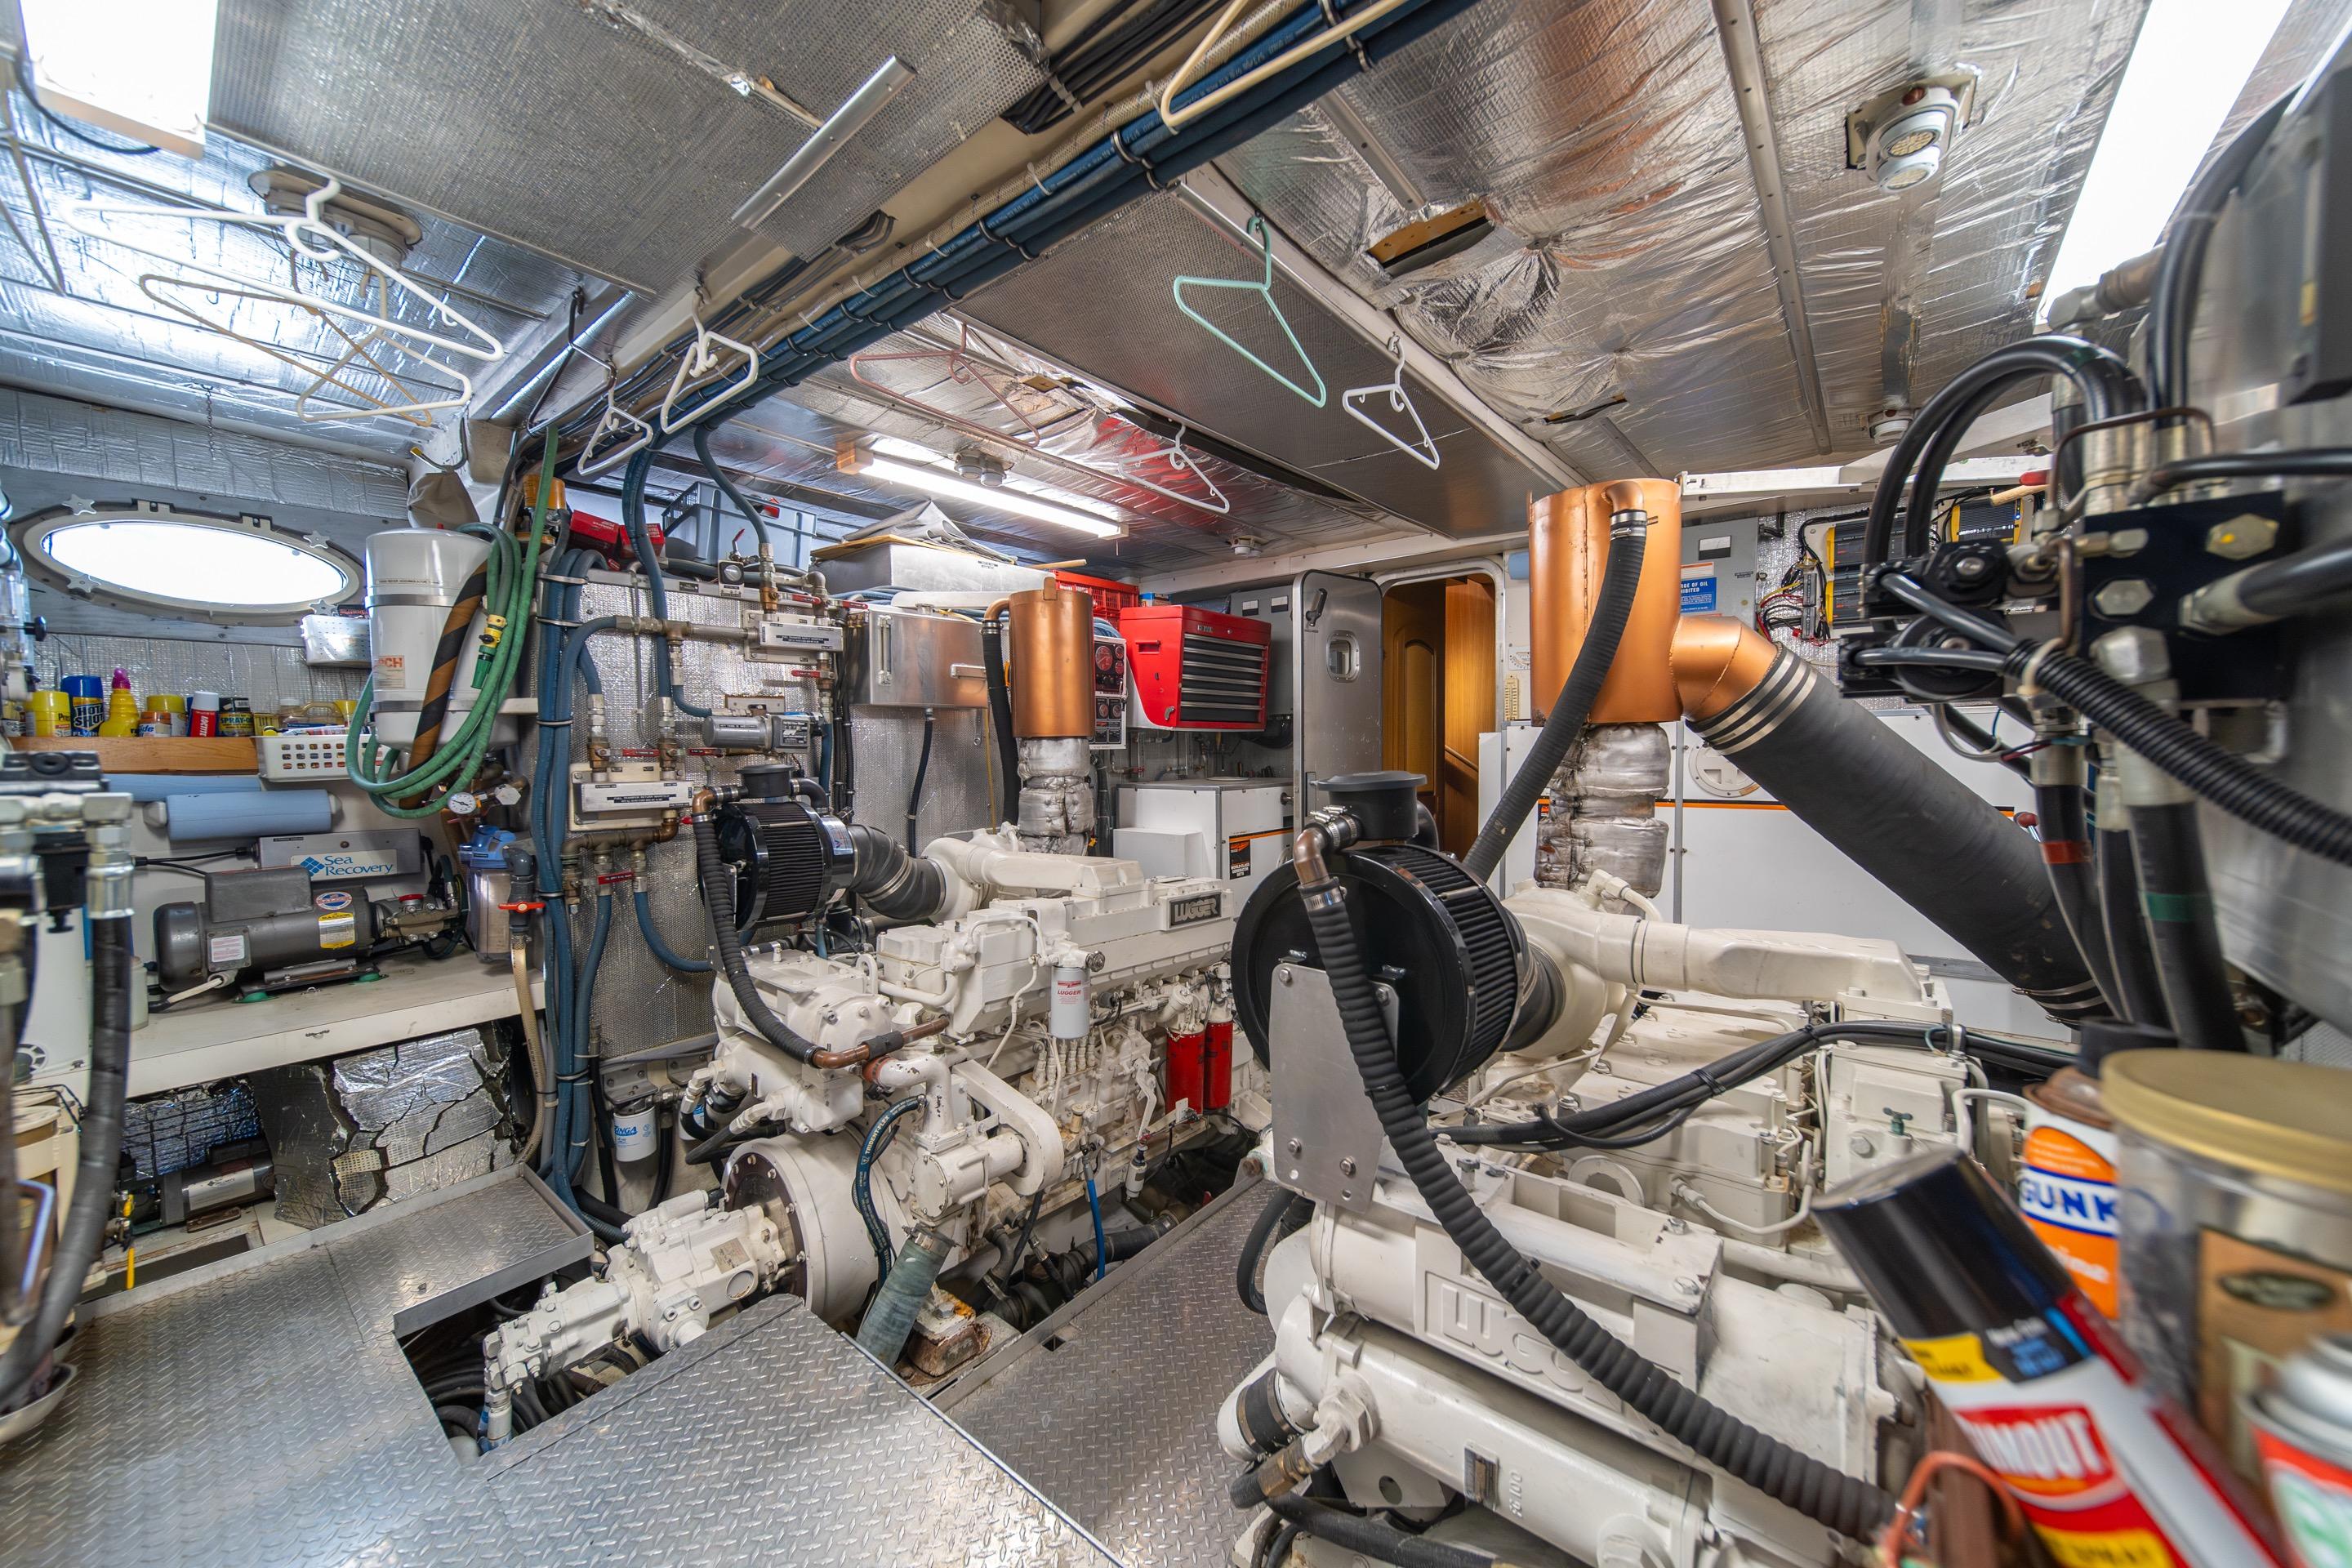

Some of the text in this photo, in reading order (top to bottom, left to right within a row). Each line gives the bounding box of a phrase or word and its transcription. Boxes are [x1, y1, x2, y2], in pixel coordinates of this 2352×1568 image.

[76, 705, 103, 716] HOT
[74, 714, 104, 728] SHOT
[324, 855, 354, 866] Sea
[325, 863, 394, 876] Recovery
[1174, 898, 1218, 923] LUGGER
